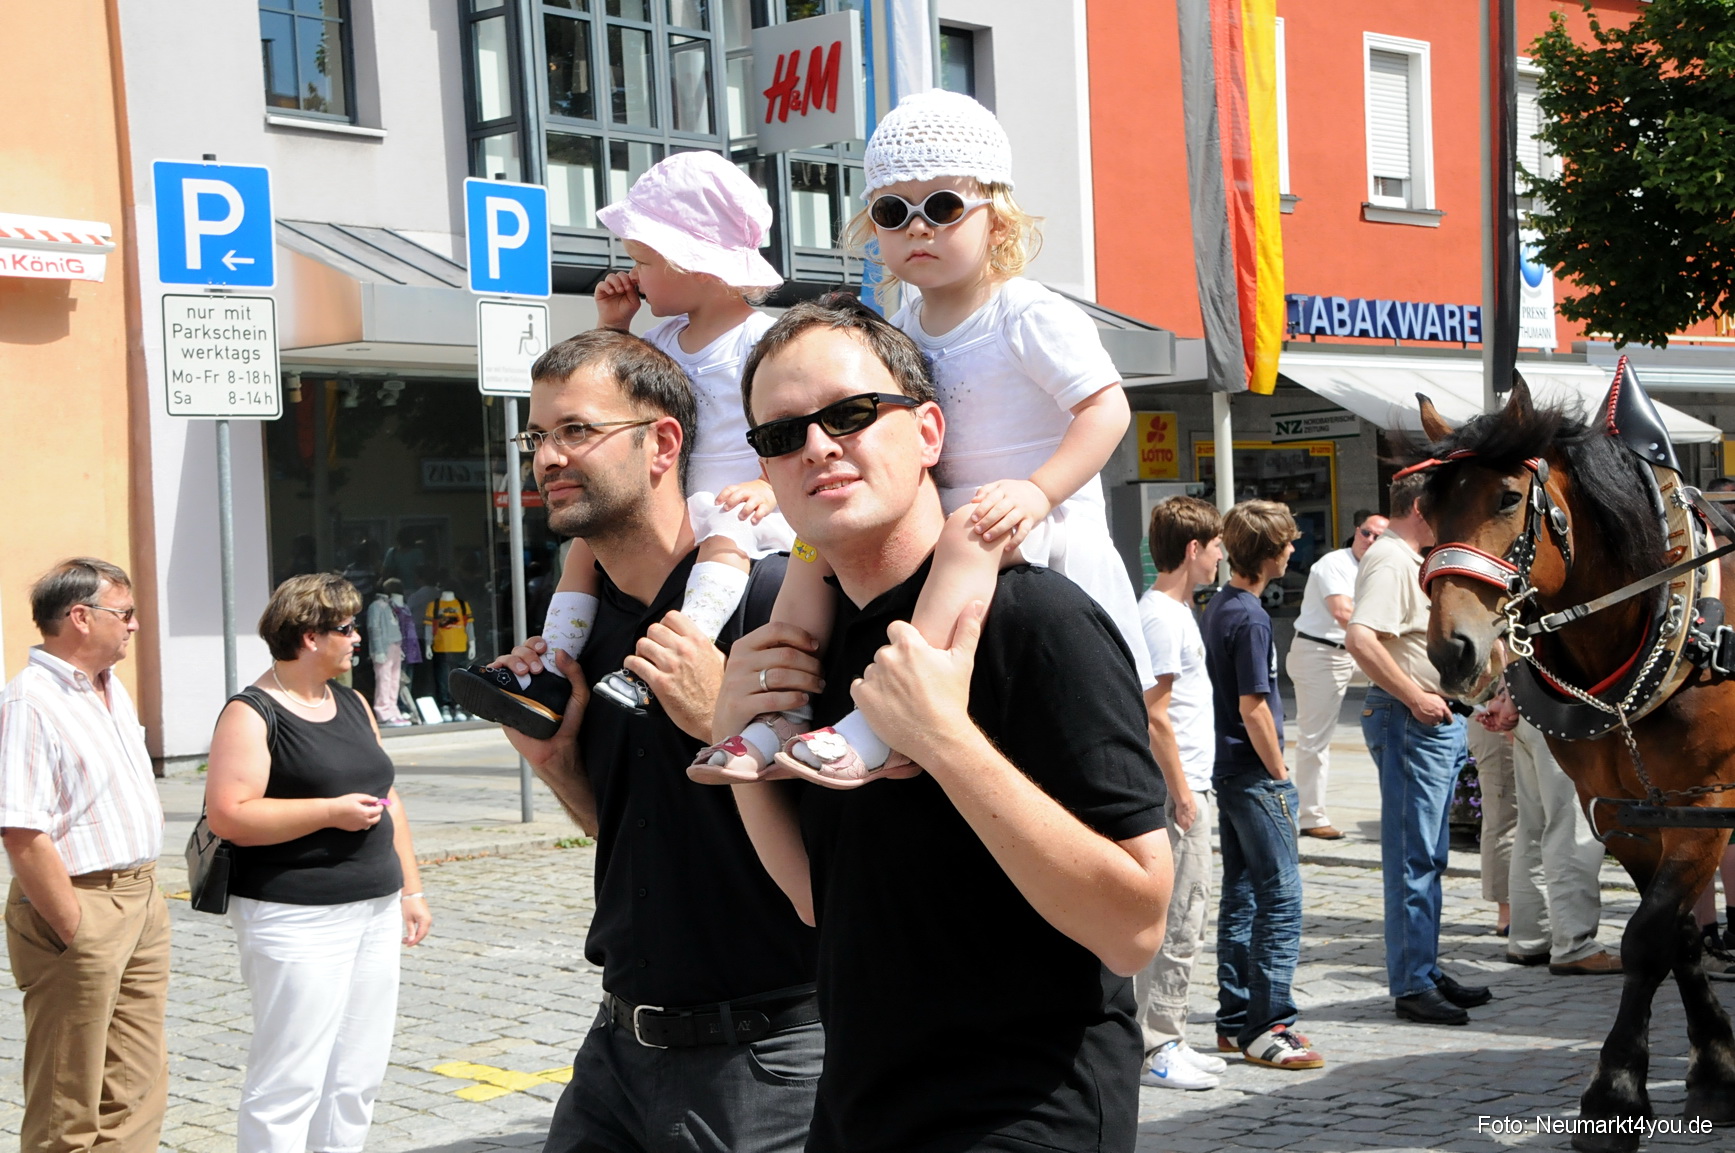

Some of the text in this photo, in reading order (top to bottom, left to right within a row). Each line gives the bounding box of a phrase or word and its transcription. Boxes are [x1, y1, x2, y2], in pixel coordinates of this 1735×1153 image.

[763, 41, 842, 124] H&M
[182, 178, 245, 270] P
[486, 196, 530, 279] P
[187, 305, 251, 320] nur mit
[1286, 293, 1483, 343] TABAKWARE
[1522, 306, 1548, 320] PRESSE
[172, 323, 267, 340] Parkschein
[181, 344, 261, 364] werktags
[172, 369, 219, 383] Mo-Fr
[174, 391, 192, 404] Sa
[1275, 419, 1303, 436] NZ
[1303, 425, 1330, 434] ZEITUNG
[1141, 448, 1174, 462] LOTTO
